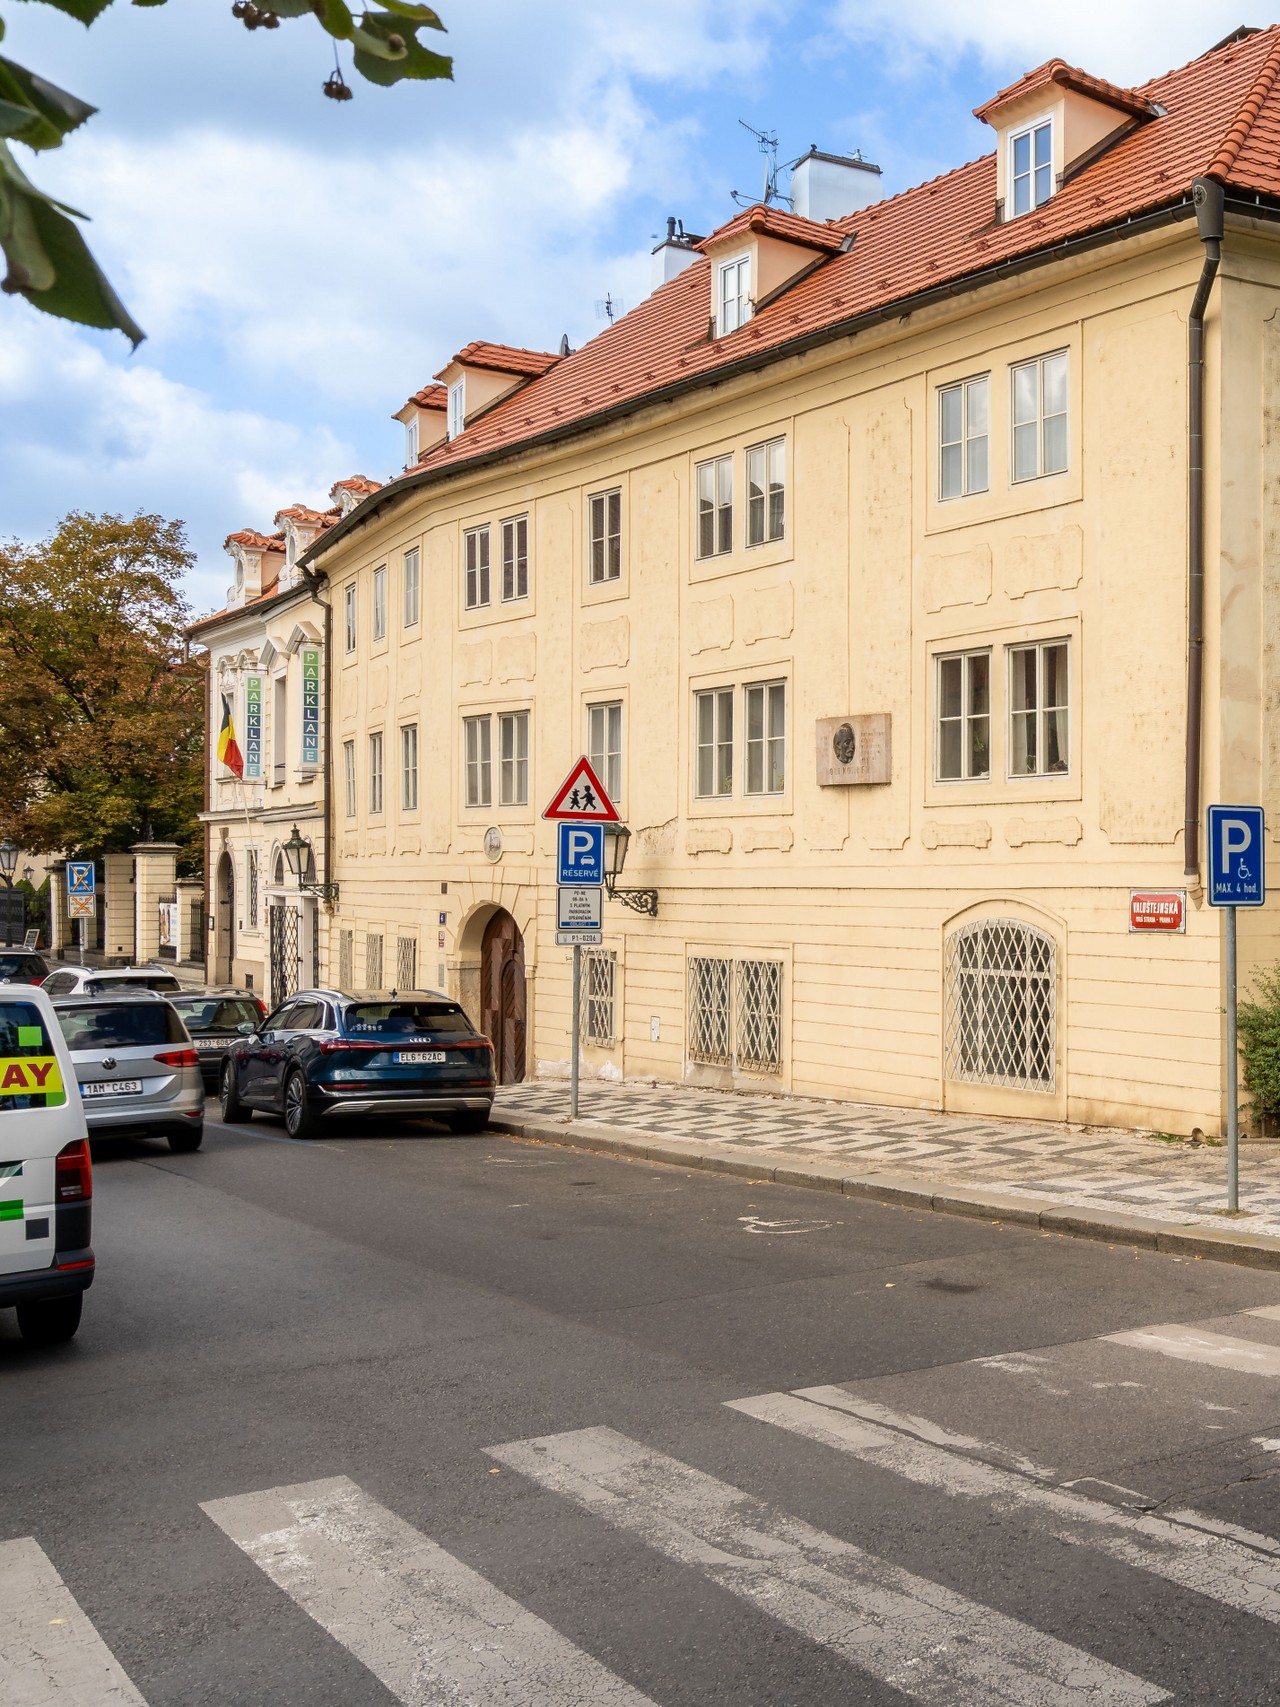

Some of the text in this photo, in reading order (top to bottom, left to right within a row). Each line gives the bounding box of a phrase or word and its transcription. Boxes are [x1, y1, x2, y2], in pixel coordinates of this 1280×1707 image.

[305, 653, 317, 761] PARKLANE
[249, 679, 259, 776] PARKLANE
[568, 830, 594, 865] P
[1221, 819, 1252, 874] P
[562, 867, 599, 878] RÉSERVÉ
[1216, 882, 1259, 893] MAX. 4 hod.
[400, 1052, 442, 1061] EL6 62AC
[86, 1082, 137, 1093] 1AM C463
